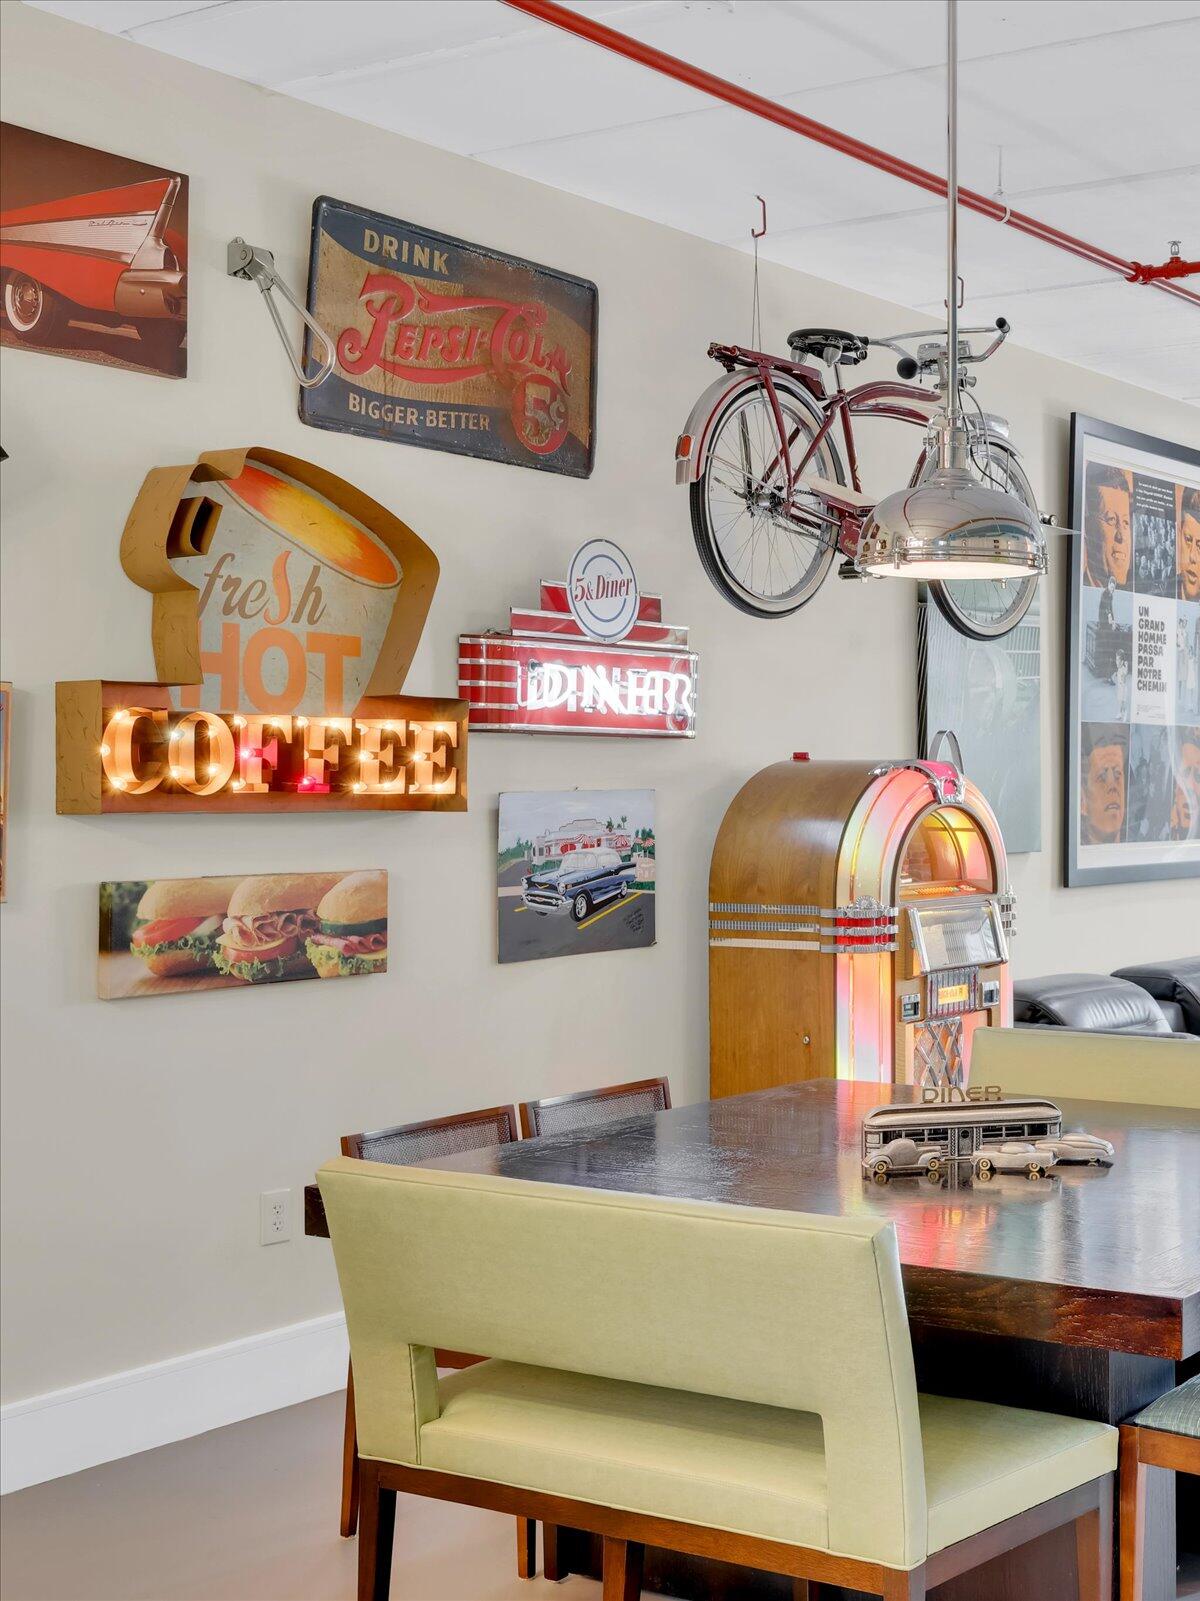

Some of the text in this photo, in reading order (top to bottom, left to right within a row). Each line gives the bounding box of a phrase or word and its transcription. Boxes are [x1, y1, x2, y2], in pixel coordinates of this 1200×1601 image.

[363, 228, 449, 275] DRINK
[348, 392, 490, 431] BIGGER-BETTER
[1138, 606, 1150, 618] UN
[1138, 618, 1166, 632] GRAND
[1138, 631, 1167, 645] HOMME
[1138, 643, 1164, 657] PASSA
[181, 619, 362, 715] HOT
[1137, 656, 1155, 668] PAR
[1137, 680, 1168, 693] CHEMIN
[100, 706, 459, 796] COFFEE
